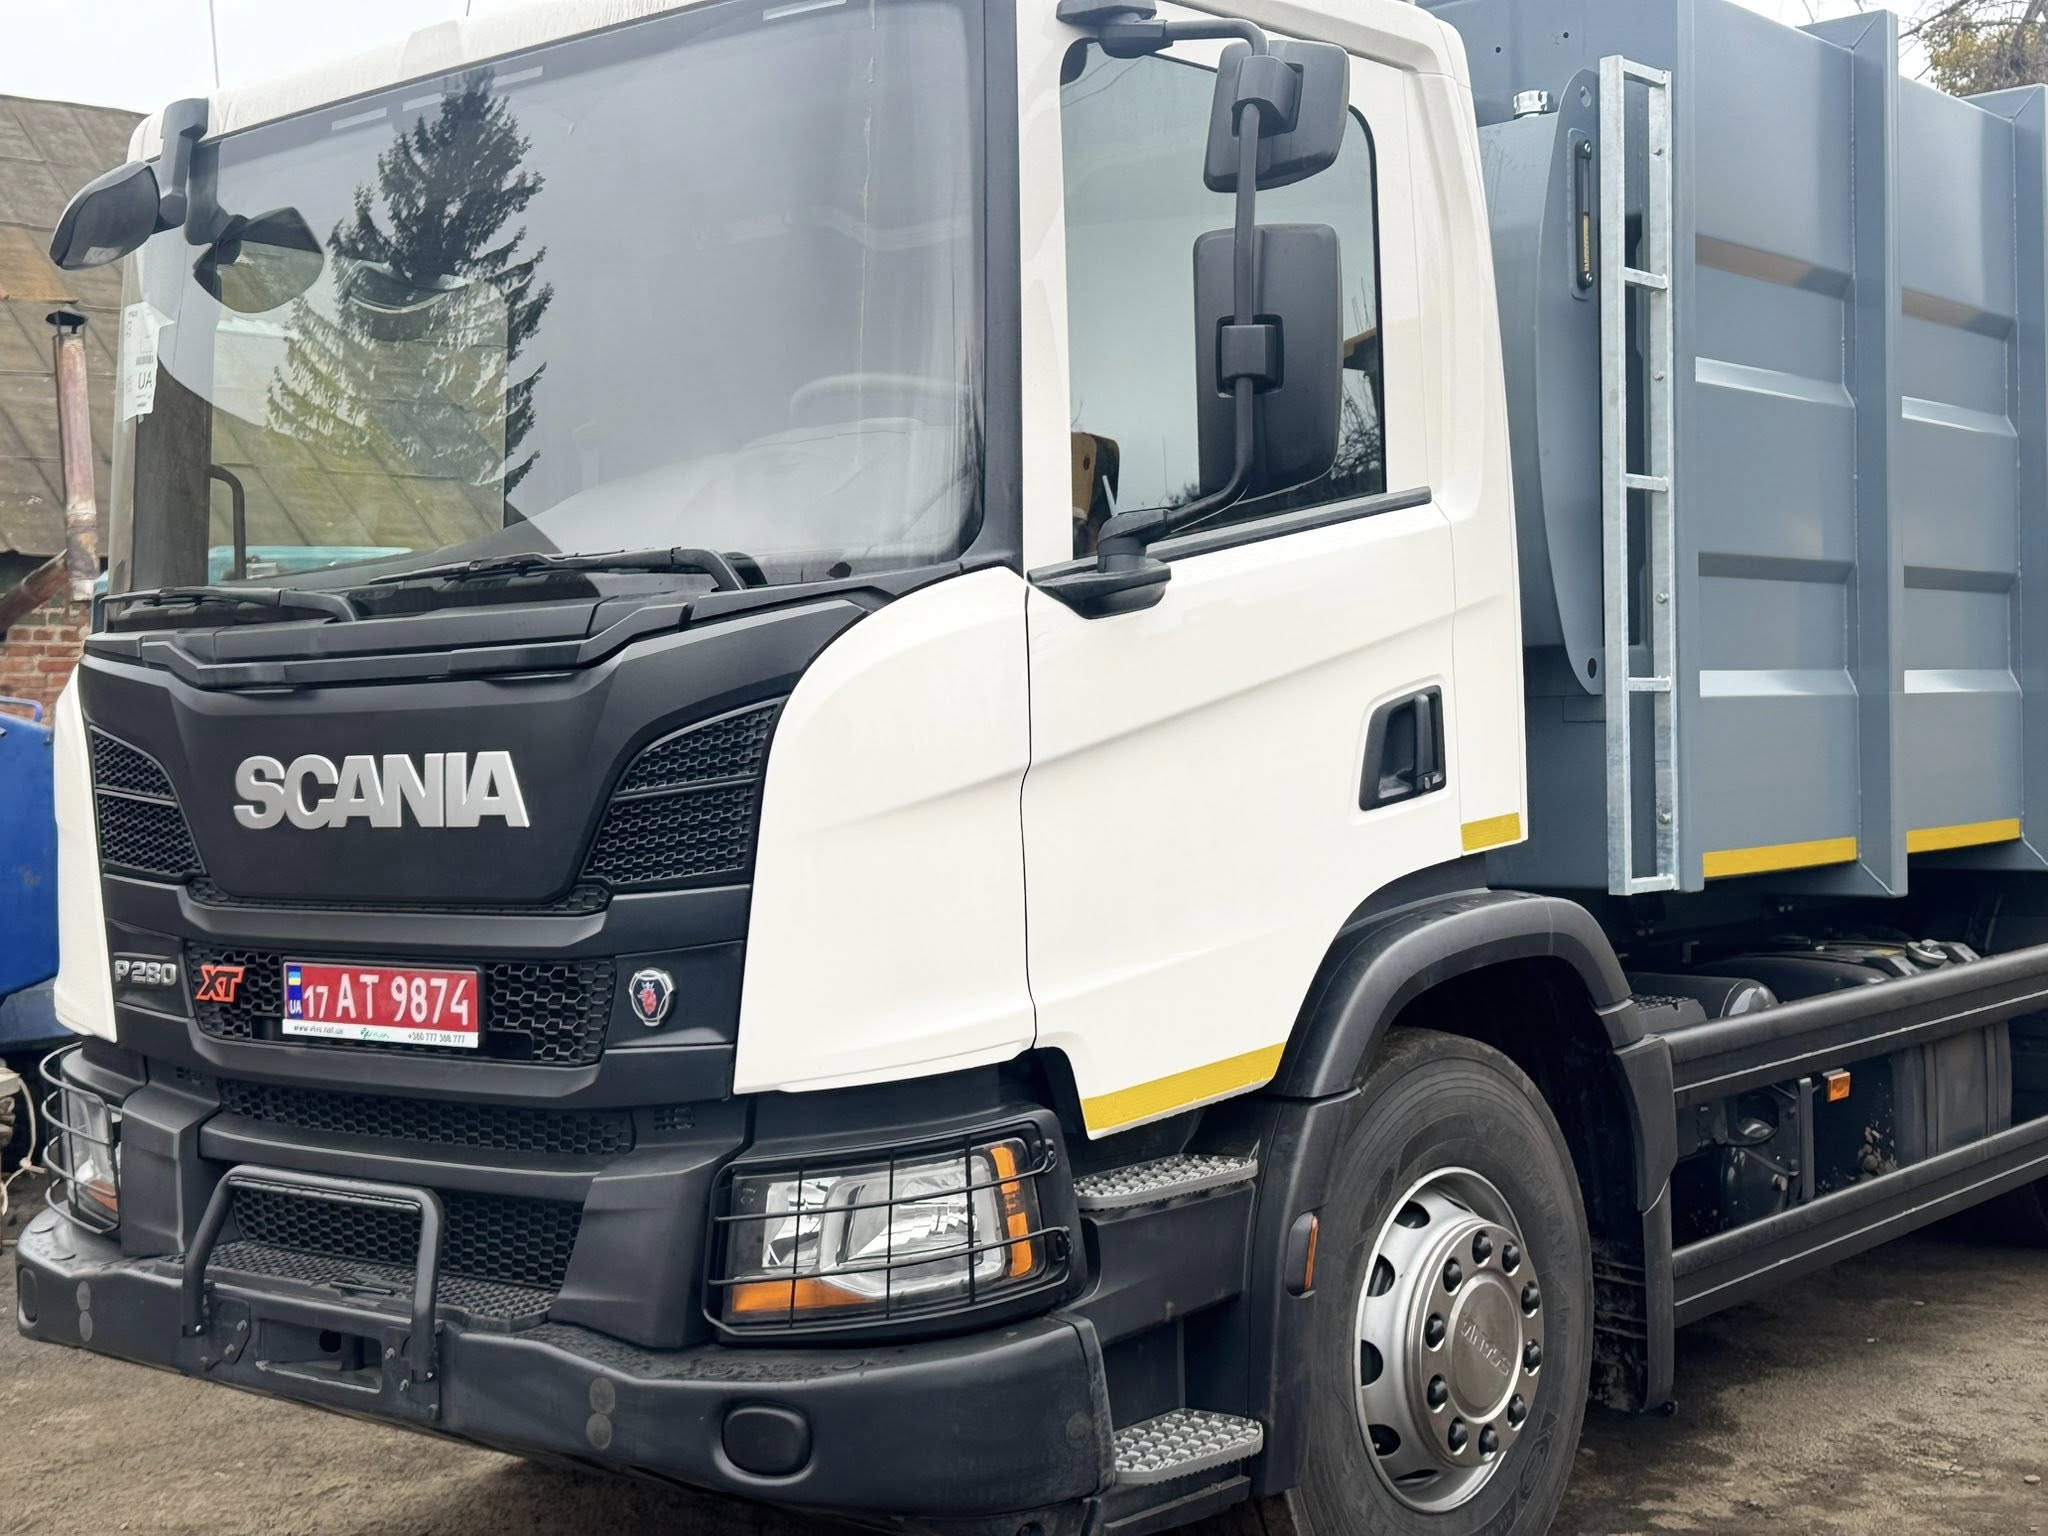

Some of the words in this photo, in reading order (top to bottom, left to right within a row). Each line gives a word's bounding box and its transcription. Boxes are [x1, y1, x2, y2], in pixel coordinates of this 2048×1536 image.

[138, 371, 153, 391] UA
[233, 751, 530, 829] SCANIA
[114, 960, 130, 983] P
[130, 961, 177, 986] 280
[196, 963, 246, 1003] XT
[288, 999, 303, 1015] UA
[303, 984, 329, 1019] 17
[335, 973, 380, 1019] AT
[390, 975, 469, 1026] 9874
